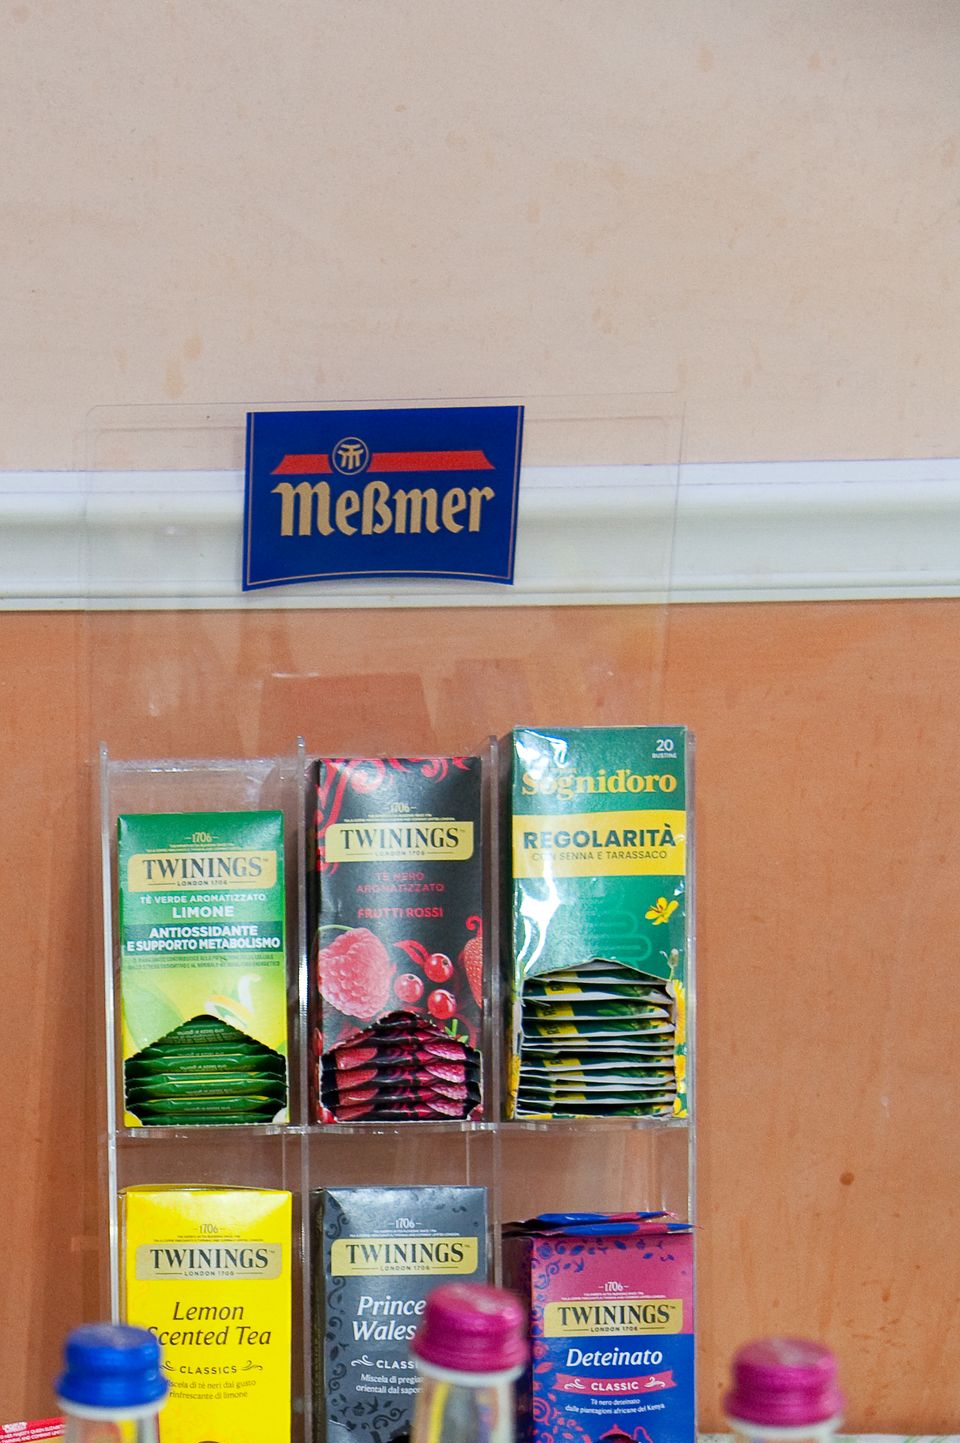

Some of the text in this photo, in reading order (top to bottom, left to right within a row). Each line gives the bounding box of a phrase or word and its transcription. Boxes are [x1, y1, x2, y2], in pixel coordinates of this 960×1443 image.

[655, 739, 674, 752] 20
[340, 827, 460, 850] TWININGS
[523, 823, 676, 849] REGOLARITÀ
[560, 851, 593, 860] SENNA
[597, 851, 603, 860] E
[606, 850, 668, 860] TARASSACO
[142, 856, 262, 880] TWININGS
[155, 895, 187, 904] VERDE
[190, 893, 266, 903] AROMATIZZATO
[172, 906, 234, 919] LIMONE
[358, 907, 444, 919] FRUTTI ROSSI
[149, 925, 258, 939] ANTIOSSIDANTE
[127, 937, 281, 952] E SUPPORTO METABOLISMO
[150, 1248, 269, 1269] TWININGS
[345, 1242, 464, 1264] TWININGS
[172, 1301, 244, 1321] Lemon
[356, 1295, 426, 1316] Prince
[557, 1304, 670, 1326] TWININGS
[236, 1326, 272, 1345] Tea
[352, 1320, 417, 1341] Wales
[566, 1347, 663, 1367] Deteinato
[179, 1366, 238, 1375] CLASSICS
[591, 1381, 639, 1391] CLASSIC
